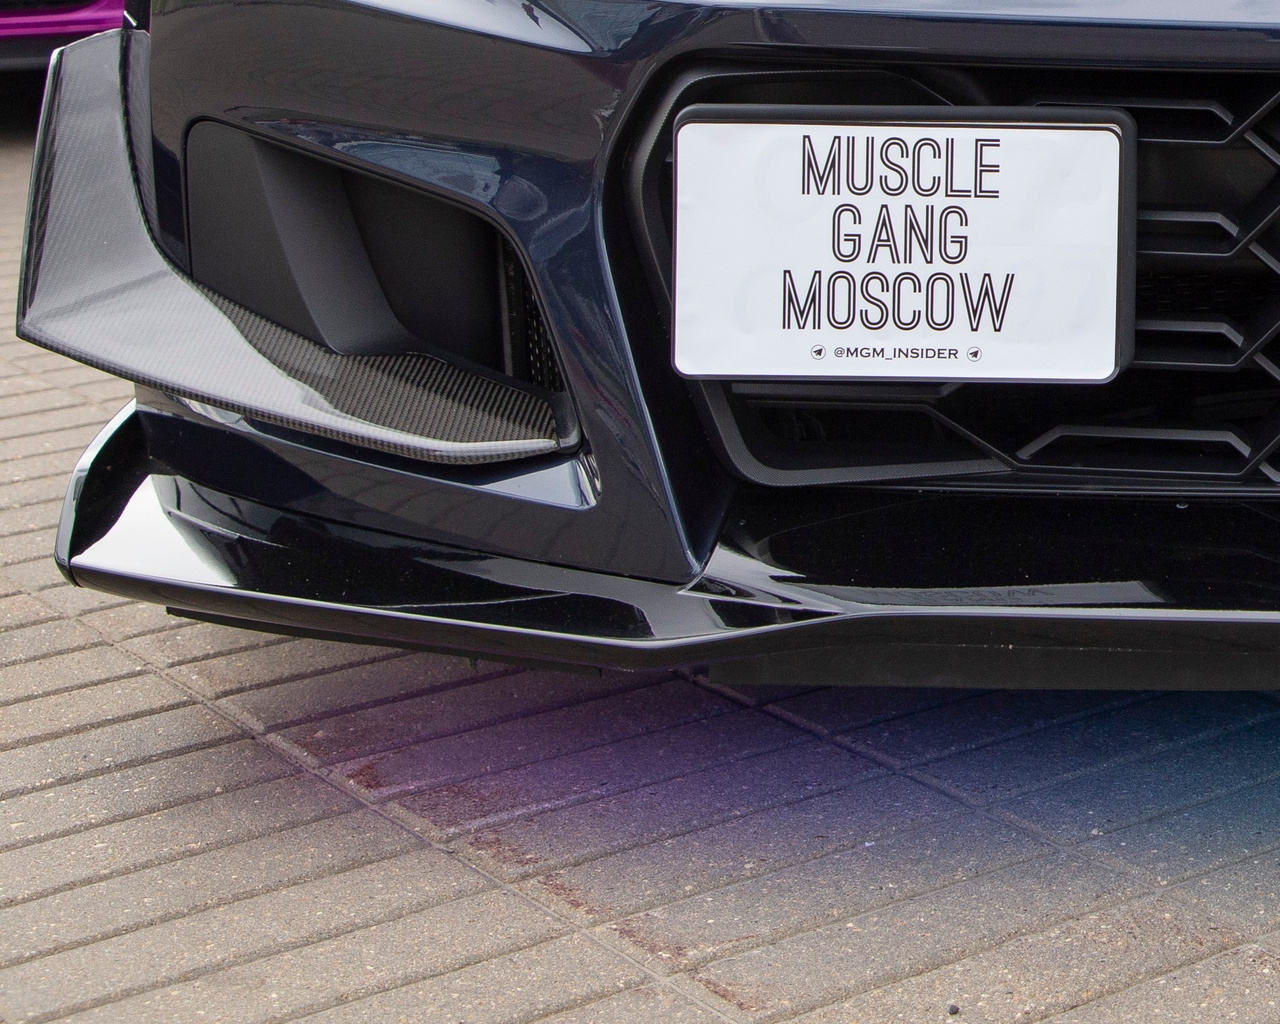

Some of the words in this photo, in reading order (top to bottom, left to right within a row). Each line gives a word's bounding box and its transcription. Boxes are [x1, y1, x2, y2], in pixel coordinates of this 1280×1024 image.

[801, 135, 1001, 198] MUSCLE
[832, 204, 969, 264] GANG
[782, 270, 1015, 332] MOSCOW
[833, 347, 959, 361] @MGM_INSIDER
